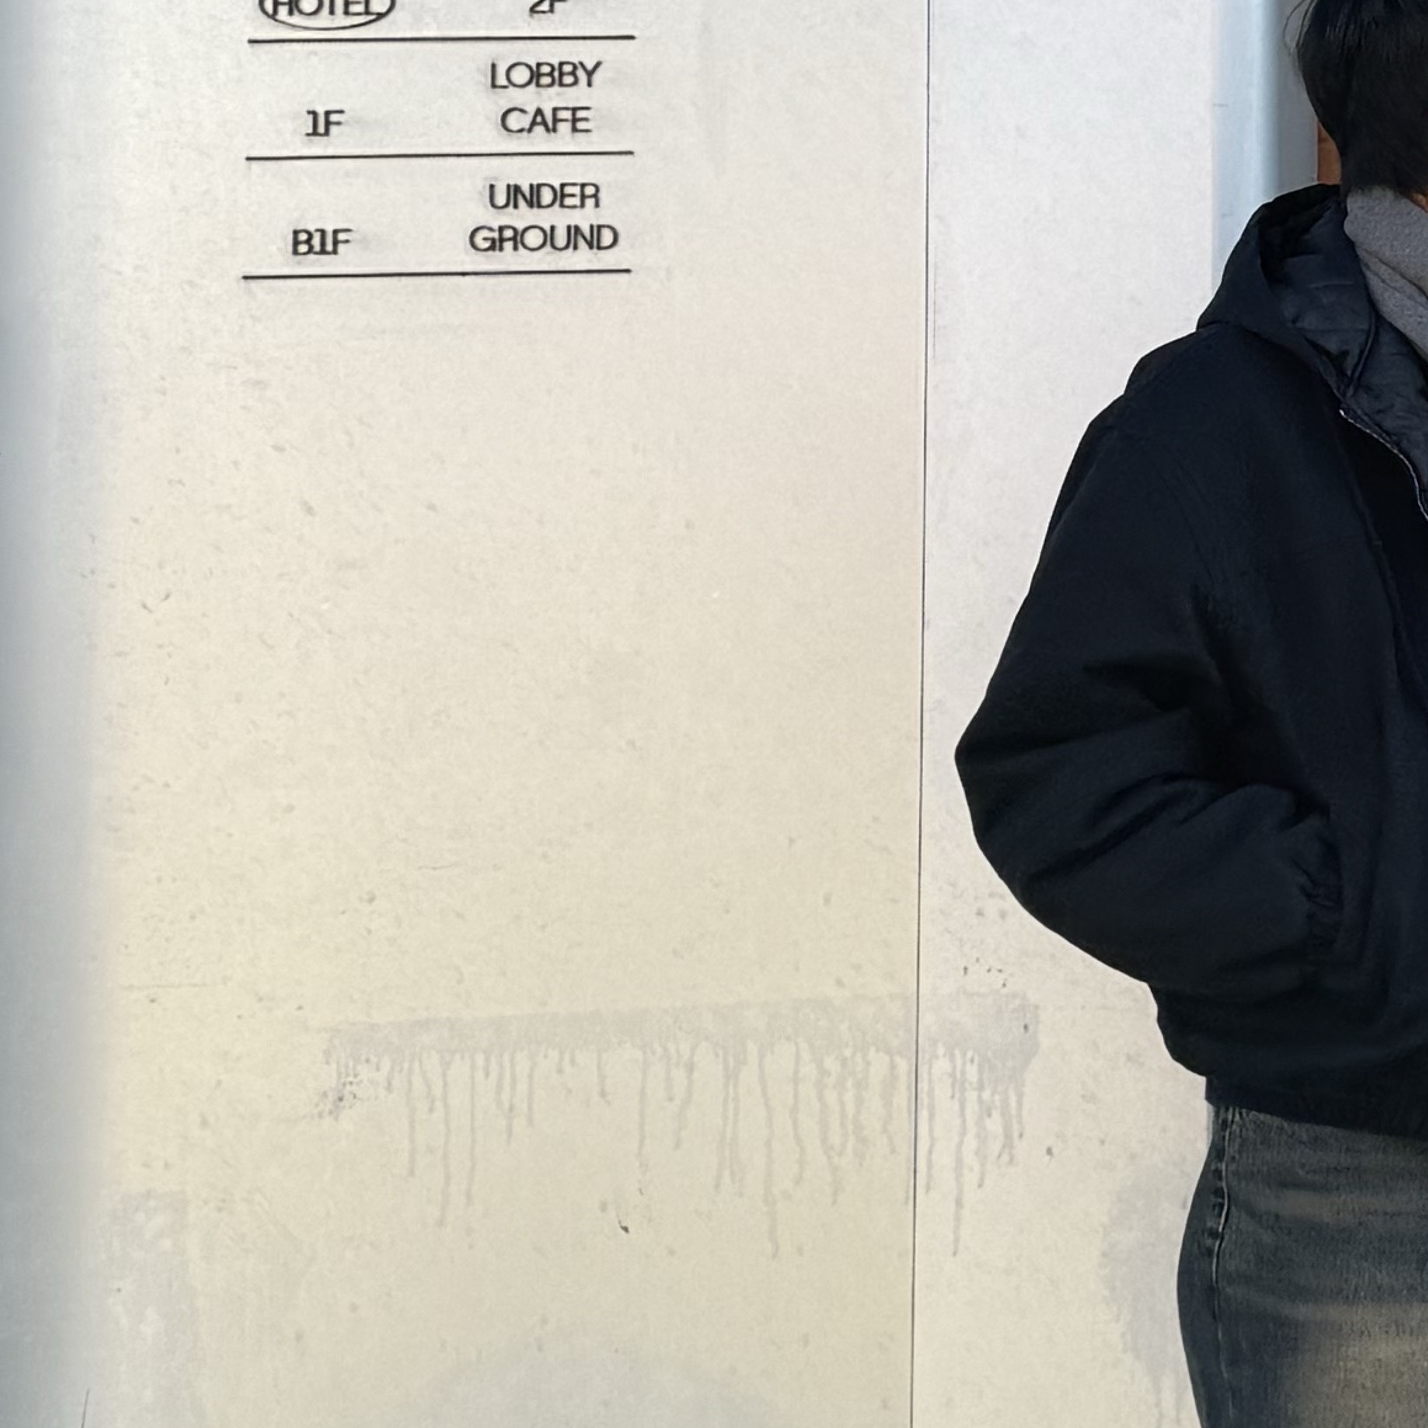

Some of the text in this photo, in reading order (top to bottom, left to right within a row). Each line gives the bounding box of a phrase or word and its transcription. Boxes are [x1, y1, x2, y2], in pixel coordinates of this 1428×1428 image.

[490, 60, 603, 90] LOBBY
[304, 106, 593, 138] 1F CAFE
[488, 182, 601, 210] UNDER
[291, 223, 620, 257] B1F GROUND
